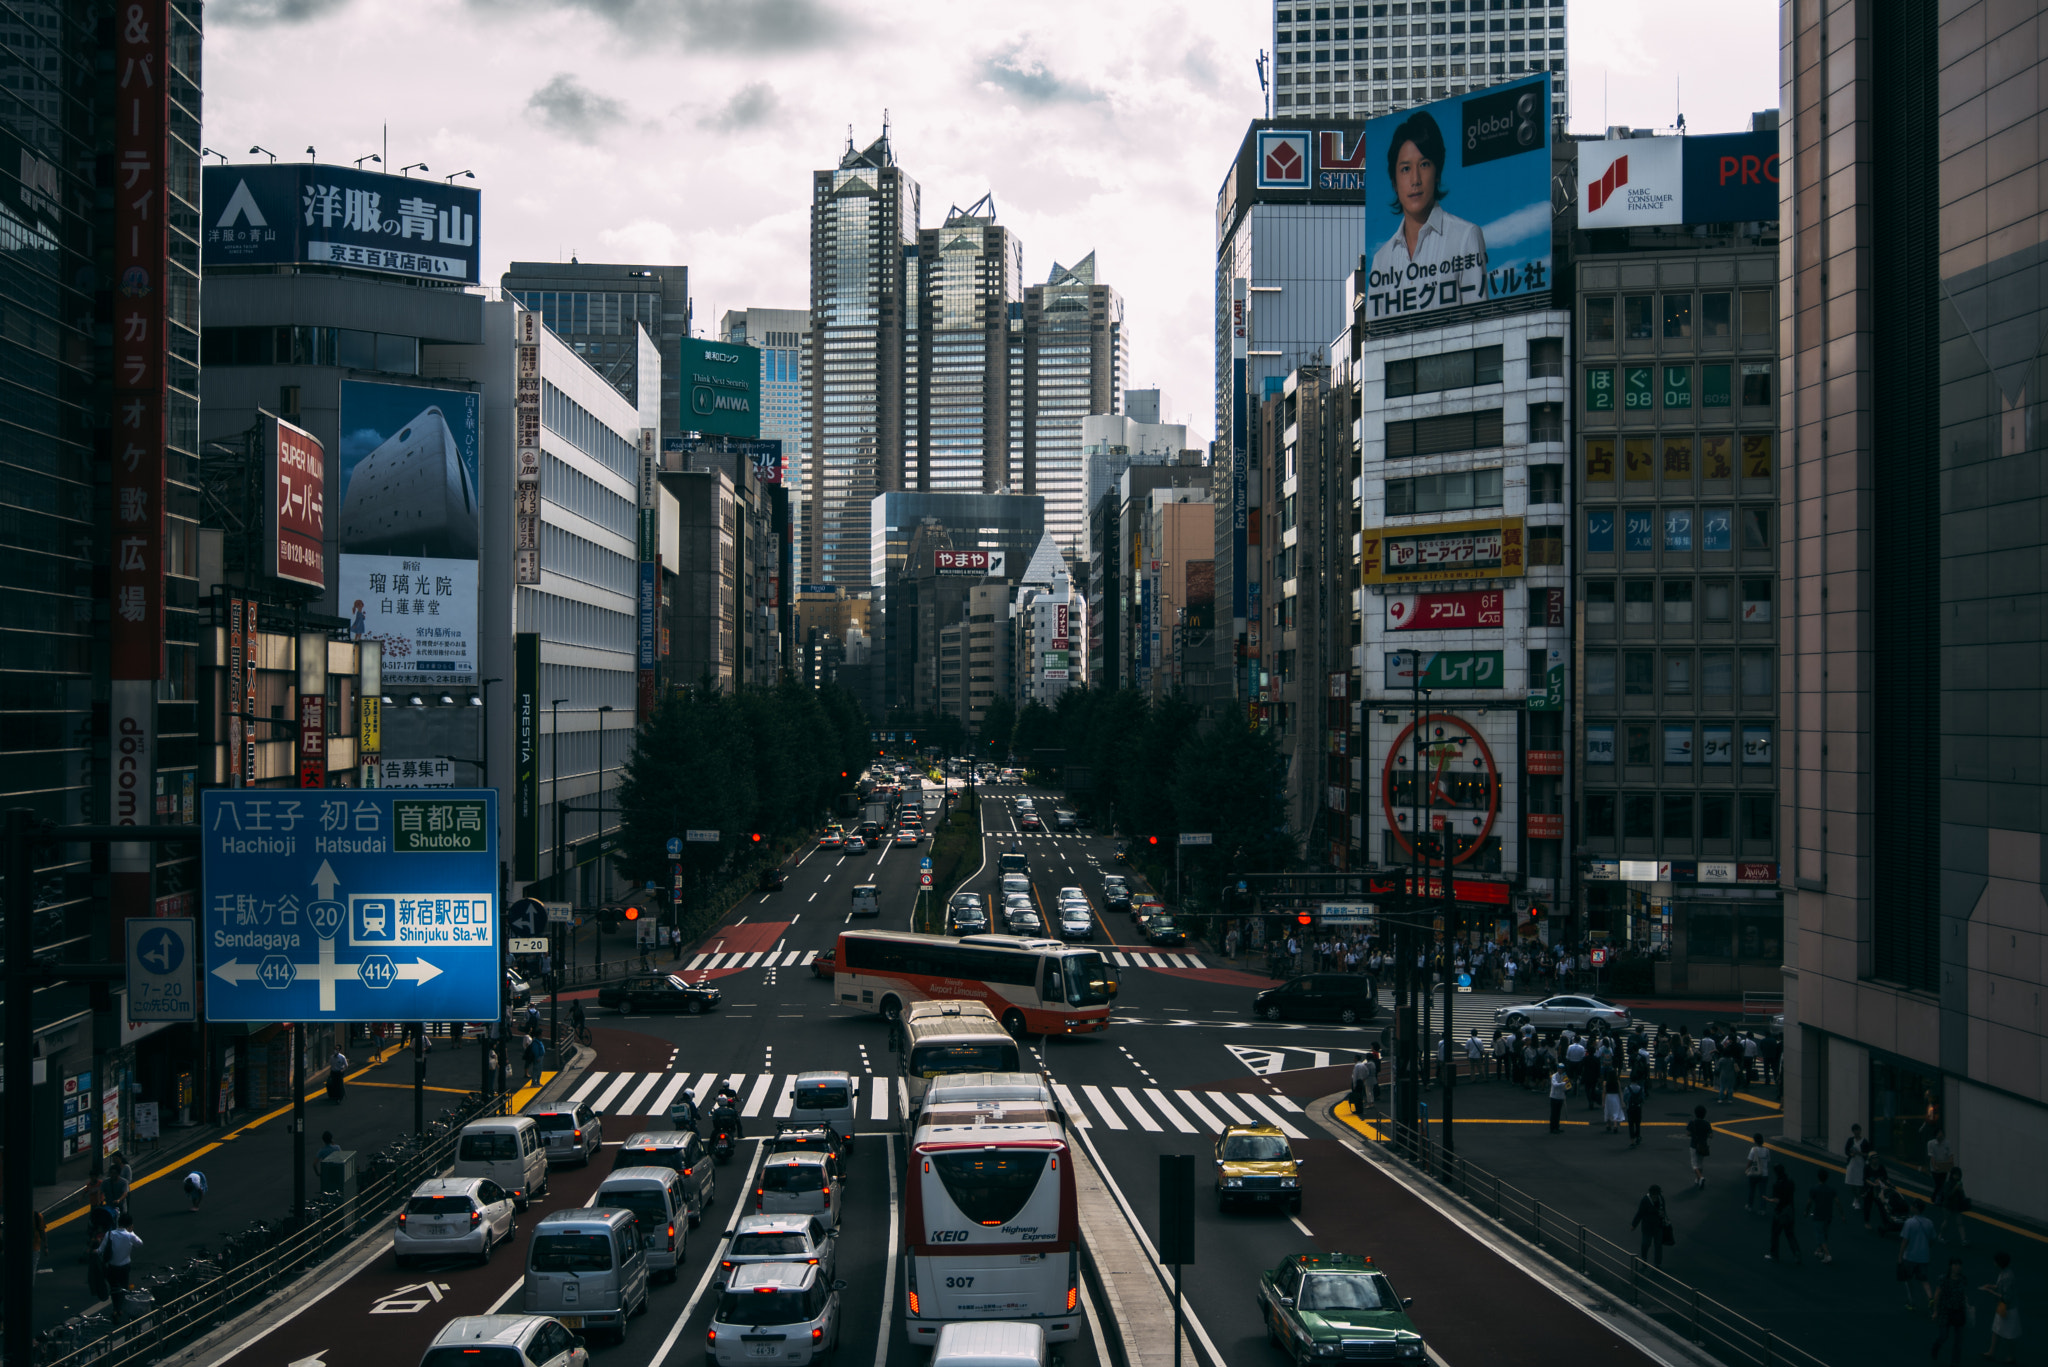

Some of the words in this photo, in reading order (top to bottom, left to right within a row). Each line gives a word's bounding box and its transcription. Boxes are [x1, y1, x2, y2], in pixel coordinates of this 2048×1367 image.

[1467, 110, 1513, 150] global
[1627, 194, 1673, 204] CONSUMER
[1628, 188, 1651, 197] SMBC
[1628, 201, 1664, 211] FINANCE
[302, 183, 473, 248] 洋服の青山
[207, 227, 276, 243] 洋服の青山
[330, 244, 449, 274] 京王百貨店向い
[1369, 265, 1404, 290] Only
[1406, 262, 1437, 282] One
[1439, 250, 1489, 275] の住まい
[1233, 299, 1243, 326] LABI
[525, 314, 533, 342] 久保ビル
[704, 350, 739, 364] 美和ロック
[518, 381, 539, 391] 共立
[692, 373, 711, 384] Think
[711, 375, 725, 386] Next
[725, 378, 750, 391] Security
[518, 393, 539, 404] 美容
[714, 395, 750, 412] MIWA
[281, 441, 306, 471] SUPER
[1234, 446, 1248, 481] JUST
[1587, 446, 1691, 476] 占い館
[118, 311, 149, 622] カラオケ歌広場
[518, 482, 538, 491] KEN
[519, 490, 527, 514] スクール
[529, 490, 537, 514] パソコン
[1235, 512, 1246, 529] For
[1417, 543, 1502, 563] エーアイアール
[1503, 527, 1523, 568] 賃貸
[402, 560, 421, 572] 新宿
[938, 552, 985, 568] やまや
[1364, 539, 1380, 575] 7F
[369, 572, 453, 596] 瑠璃光院
[641, 579, 652, 615] JAPAN
[1481, 594, 1498, 608] 6F
[380, 597, 440, 616] 白蓮華堂
[1430, 601, 1466, 619] アコム
[1549, 590, 1561, 625] アコム
[641, 616, 652, 639] TOTAL
[1488, 614, 1501, 624] 入口
[641, 640, 652, 665] CLUB
[1402, 656, 1427, 666] 新生行
[1440, 656, 1495, 682] レイク
[1551, 672, 1561, 704] レイク
[1529, 698, 1546, 707] レイク
[302, 704, 322, 753] 指圧
[363, 698, 371, 746] エスジーマックス
[1589, 740, 1613, 753] 賃貸
[1704, 741, 1771, 756] タイセイ
[362, 755, 379, 765] KM
[213, 800, 305, 832] 八王子
[319, 799, 383, 832] 初台
[398, 804, 482, 832] 首都高
[1432, 817, 1443, 828] FK
[222, 836, 296, 857] Hachioji
[315, 836, 387, 853] Hatsudai
[409, 832, 471, 848] Shutoko
[1706, 869, 1728, 877] AQUA
[315, 907, 337, 927] 20
[399, 898, 487, 925] 新宿駅西口
[214, 929, 301, 951] Sendagaya
[400, 927, 449, 942] Shinjuku
[453, 927, 489, 942] Sta.-W.
[263, 963, 289, 980] 414
[364, 963, 390, 980] 414
[929, 984, 953, 996] Airport
[953, 987, 988, 999] Limousine
[134, 998, 190, 1012] この先50m
[931, 1230, 969, 1242] KEIO
[1001, 1226, 1039, 1235] Highway
[1021, 1232, 1057, 1241] Express
[945, 1276, 975, 1289] 307
